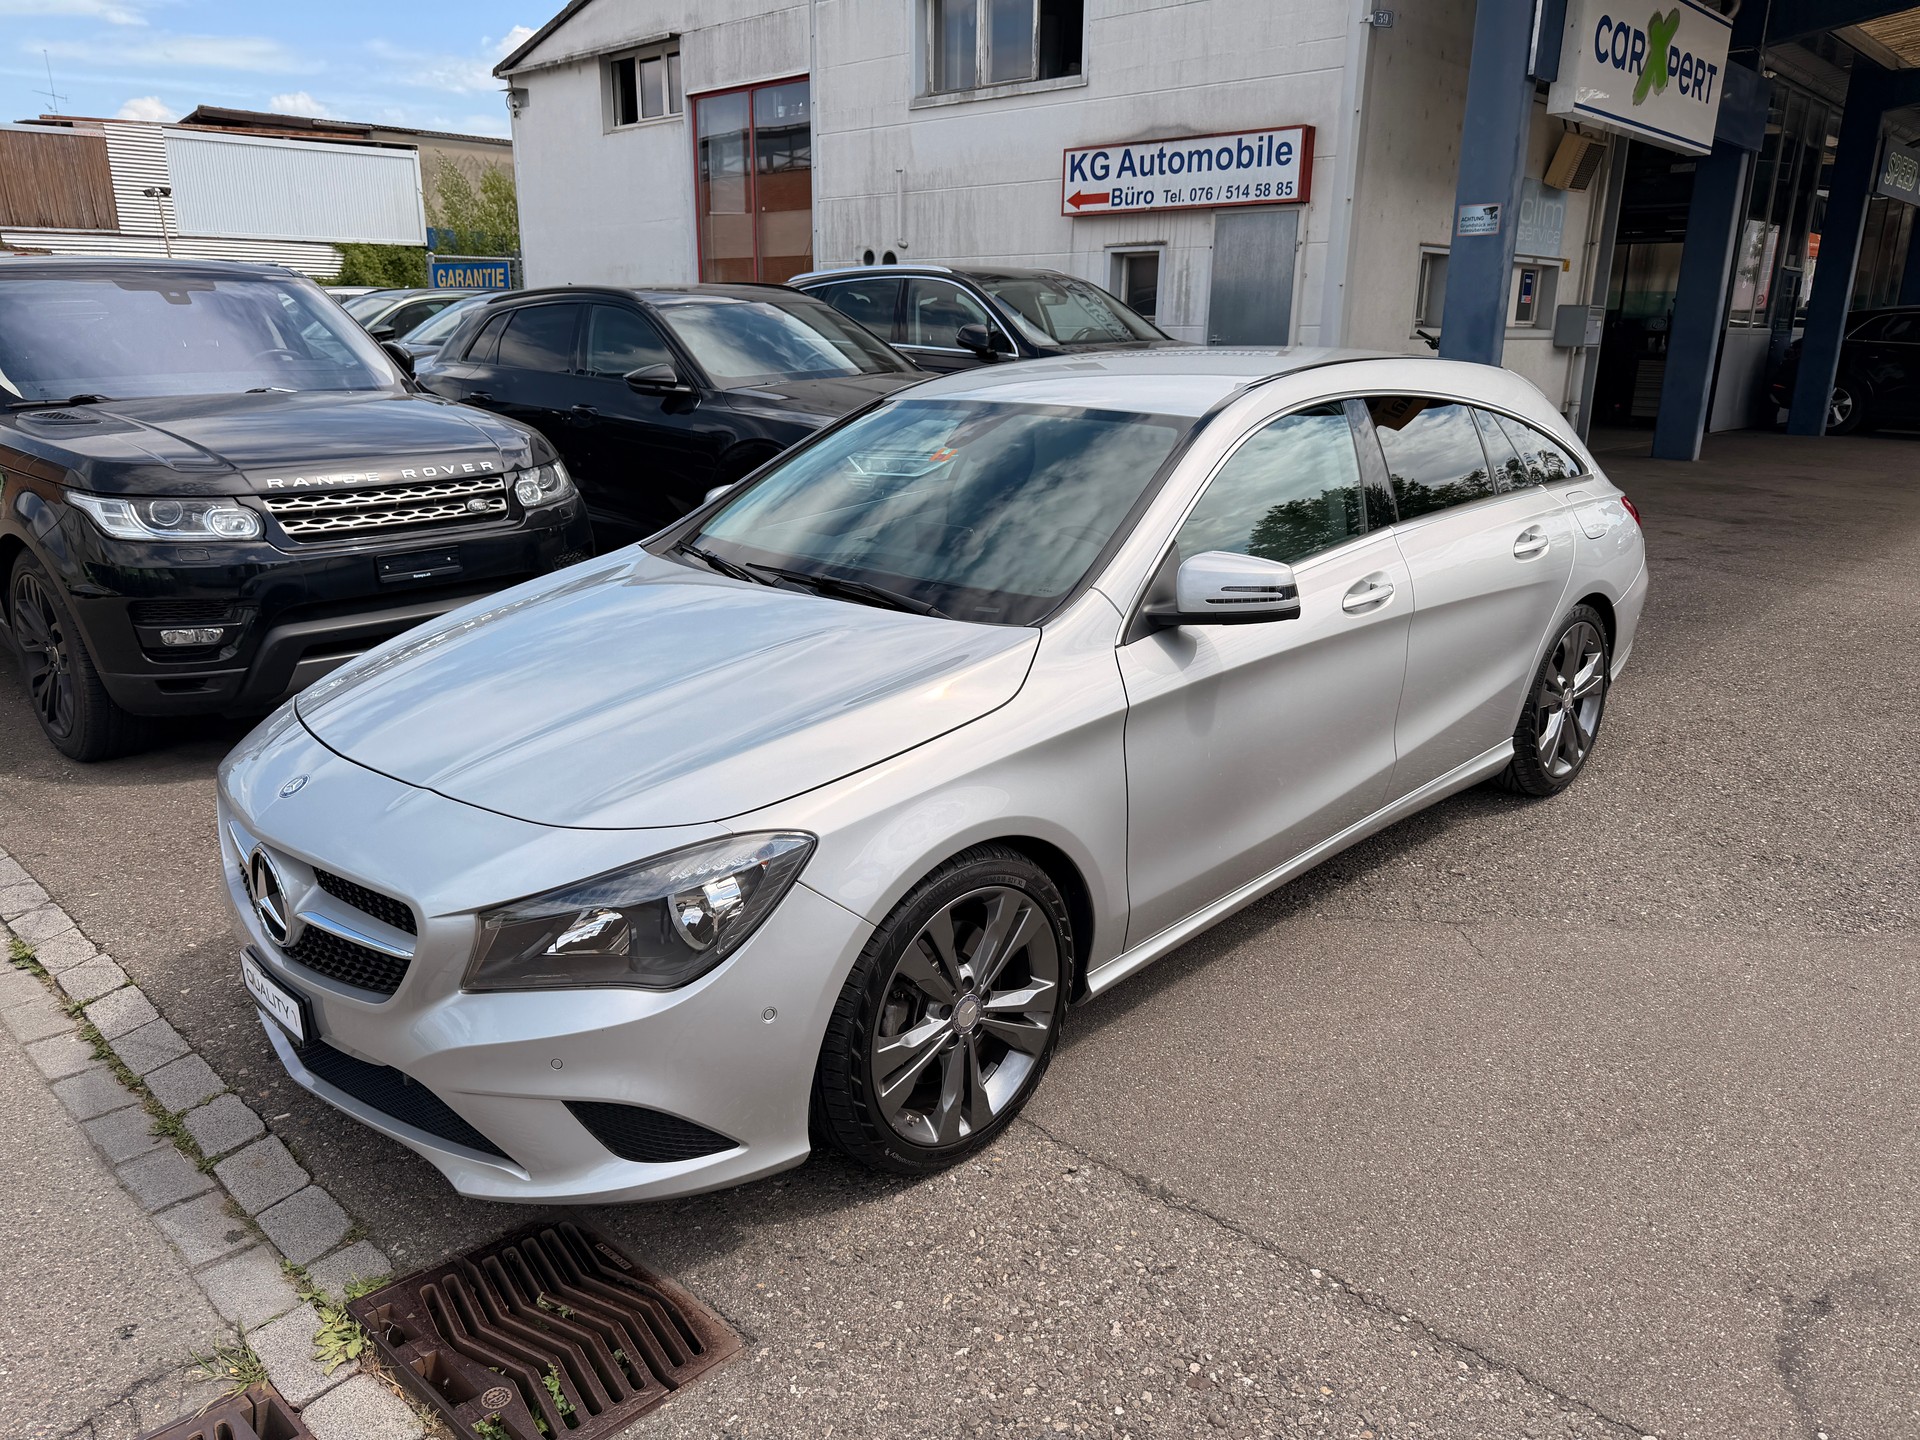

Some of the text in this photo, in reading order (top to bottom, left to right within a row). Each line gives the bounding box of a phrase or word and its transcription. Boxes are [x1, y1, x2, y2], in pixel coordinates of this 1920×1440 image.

[1069, 134, 1293, 182] KG Automobile
[1884, 151, 1919, 192] SPEED
[1111, 181, 1293, 207] Büro Tel. 076 / 514 58 85
[437, 268, 505, 288] GARANTIE
[266, 461, 494, 489] RANGE ROVER
